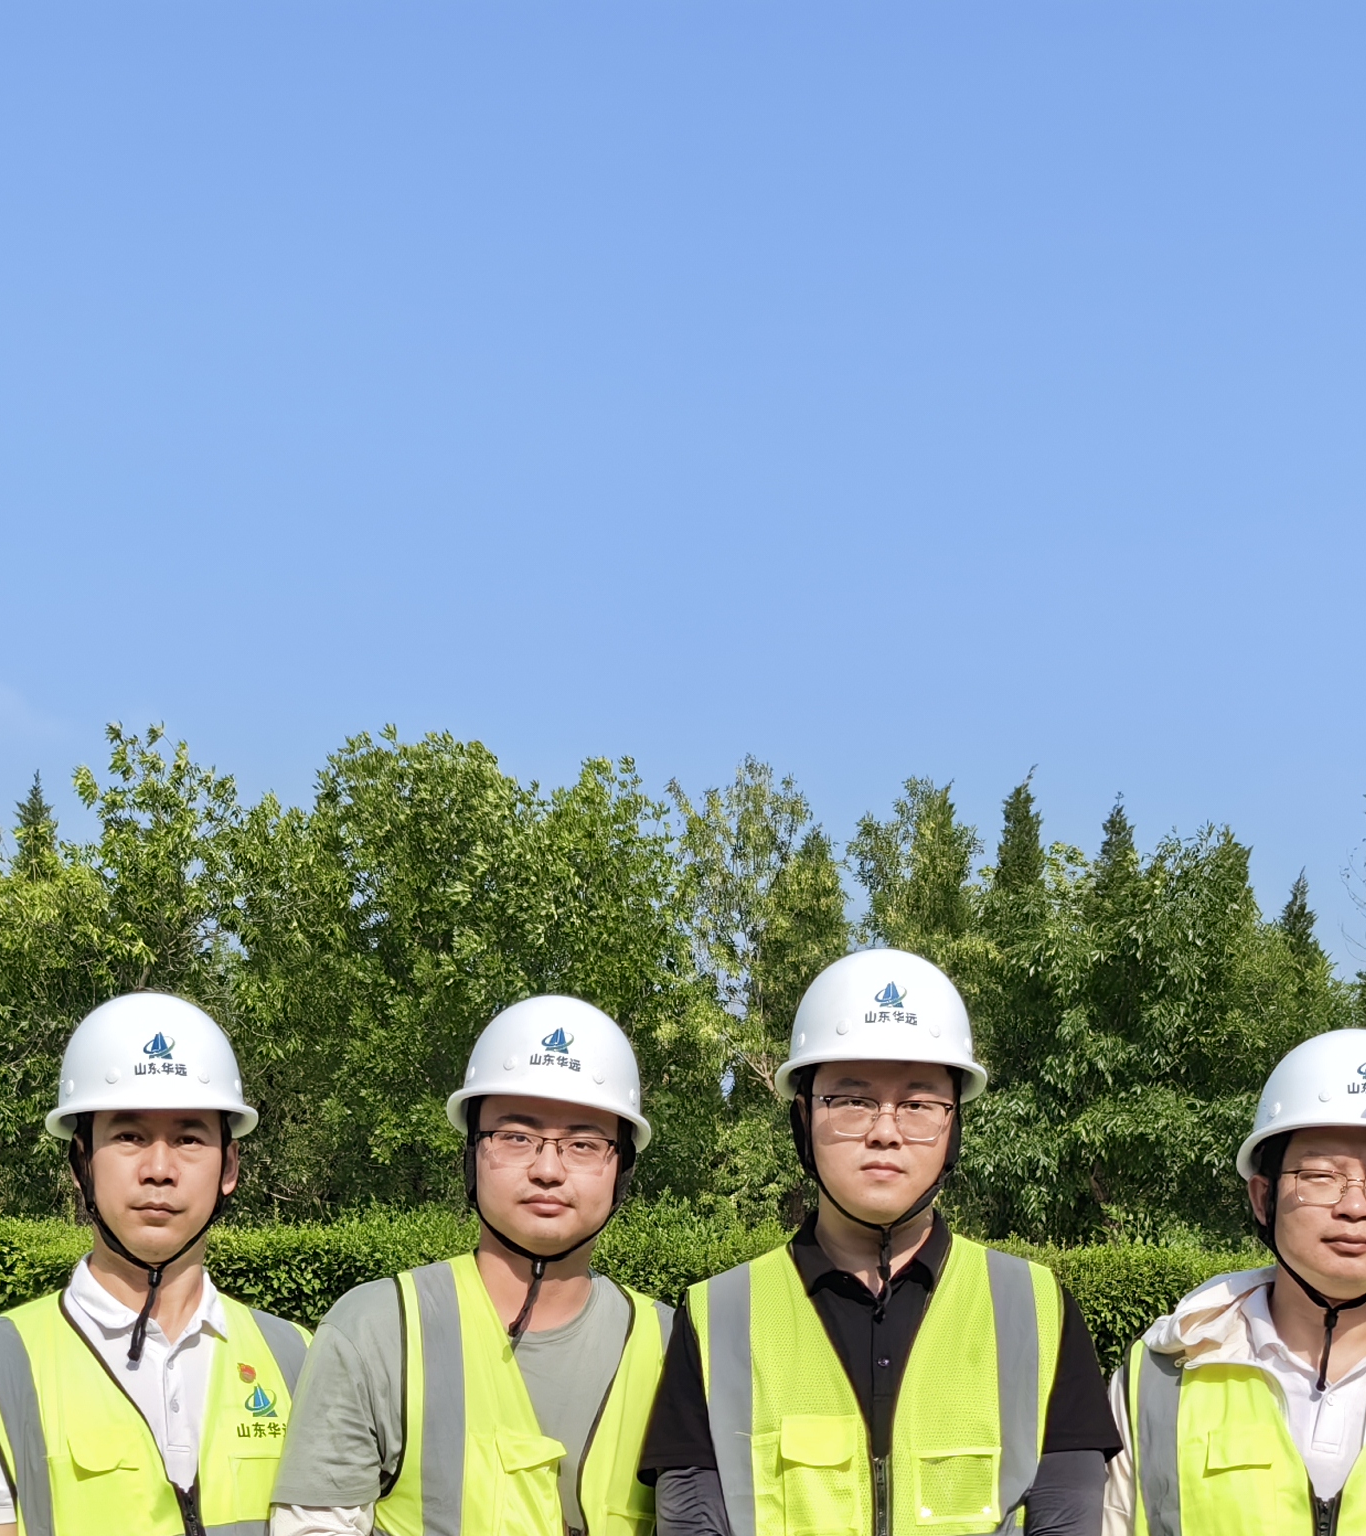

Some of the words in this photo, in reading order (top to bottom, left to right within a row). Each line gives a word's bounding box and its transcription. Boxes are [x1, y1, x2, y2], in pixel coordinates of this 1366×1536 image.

[865, 1011, 918, 1026] 山东华远
[134, 1062, 188, 1077] 山东华远
[529, 1053, 580, 1072] 山东华远
[236, 1421, 287, 1439] 山东华
